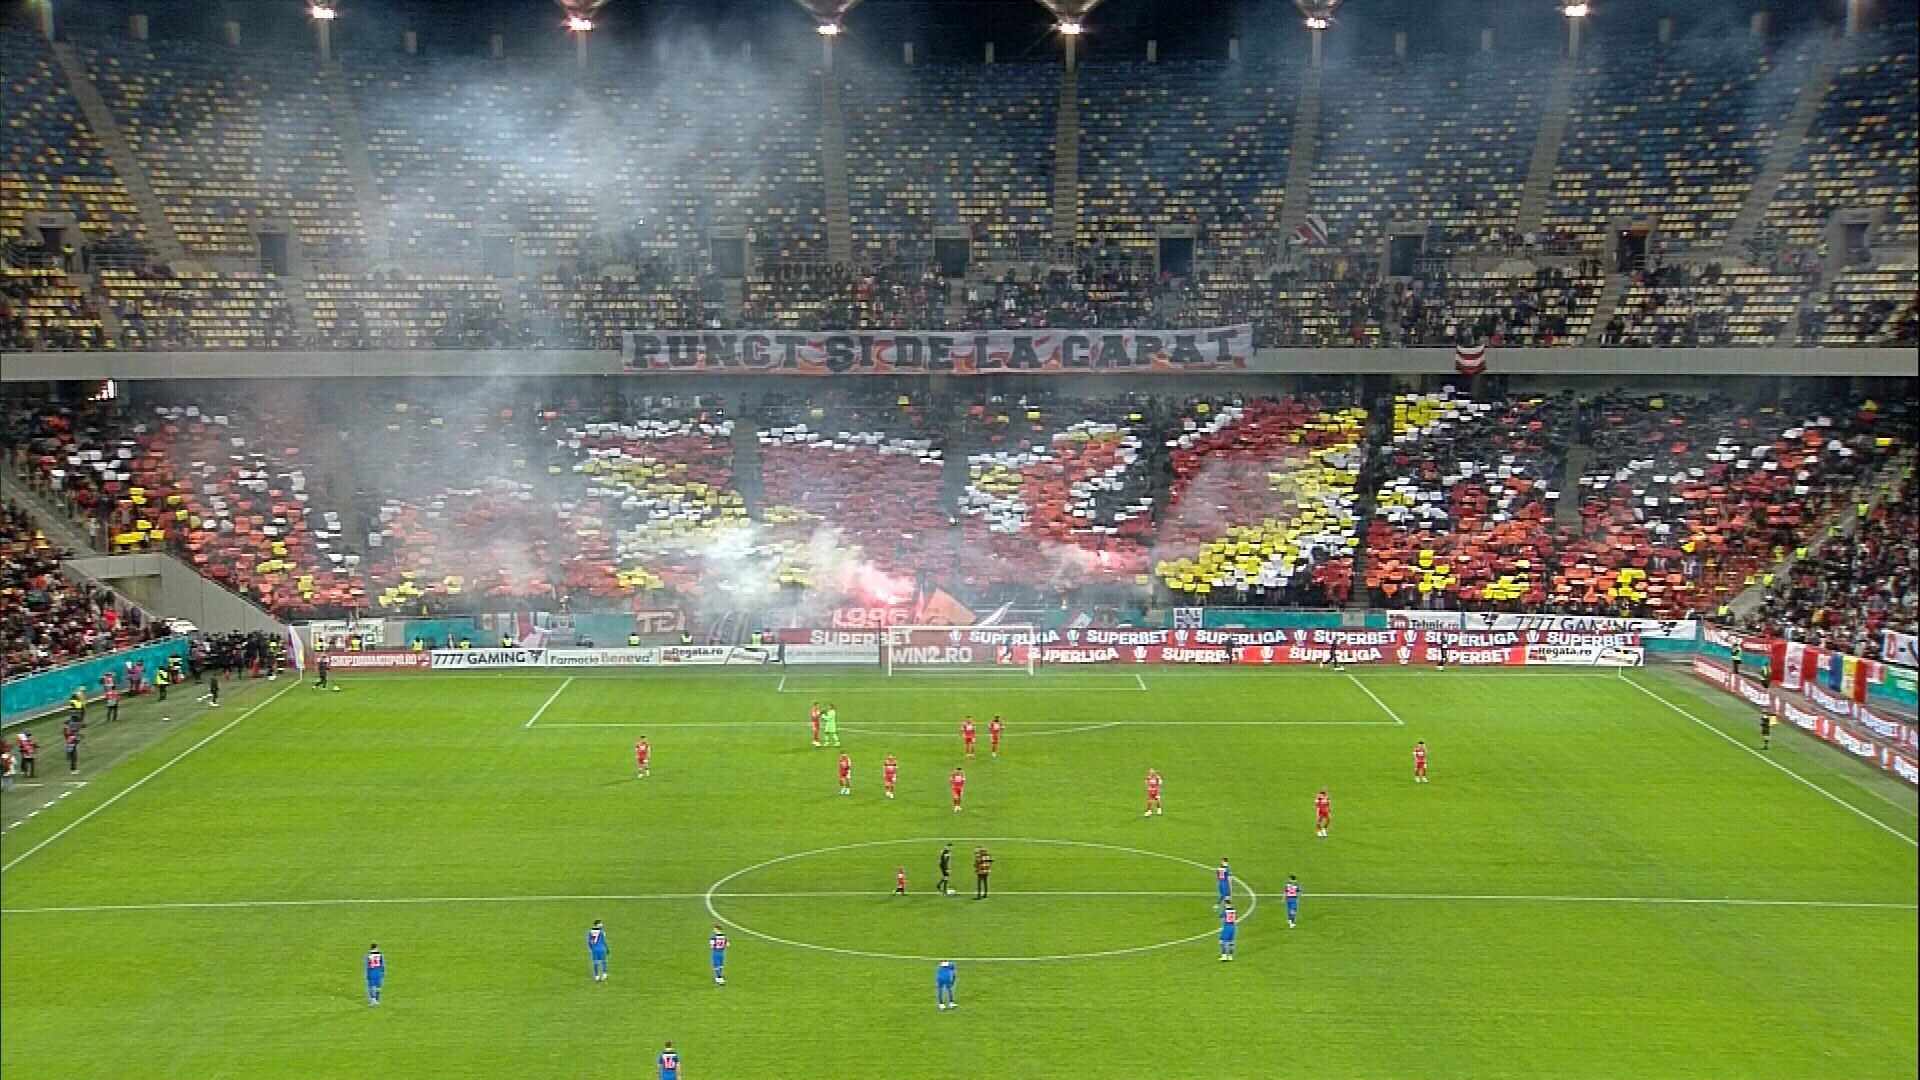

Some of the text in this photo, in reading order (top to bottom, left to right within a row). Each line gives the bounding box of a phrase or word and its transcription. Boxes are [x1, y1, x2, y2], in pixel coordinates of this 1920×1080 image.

[632, 335, 799, 368] PUNCT
[895, 335, 955, 370] DE
[974, 335, 1042, 368] LA
[810, 629, 912, 646] SUPERBET
[1086, 629, 1168, 645] SUPERBET
[1314, 629, 1397, 645] SUPERBET
[1547, 630, 1633, 647] SUPERBET
[434, 651, 525, 665] 7777 GAMING
[891, 646, 973, 664] WIN2.RO
